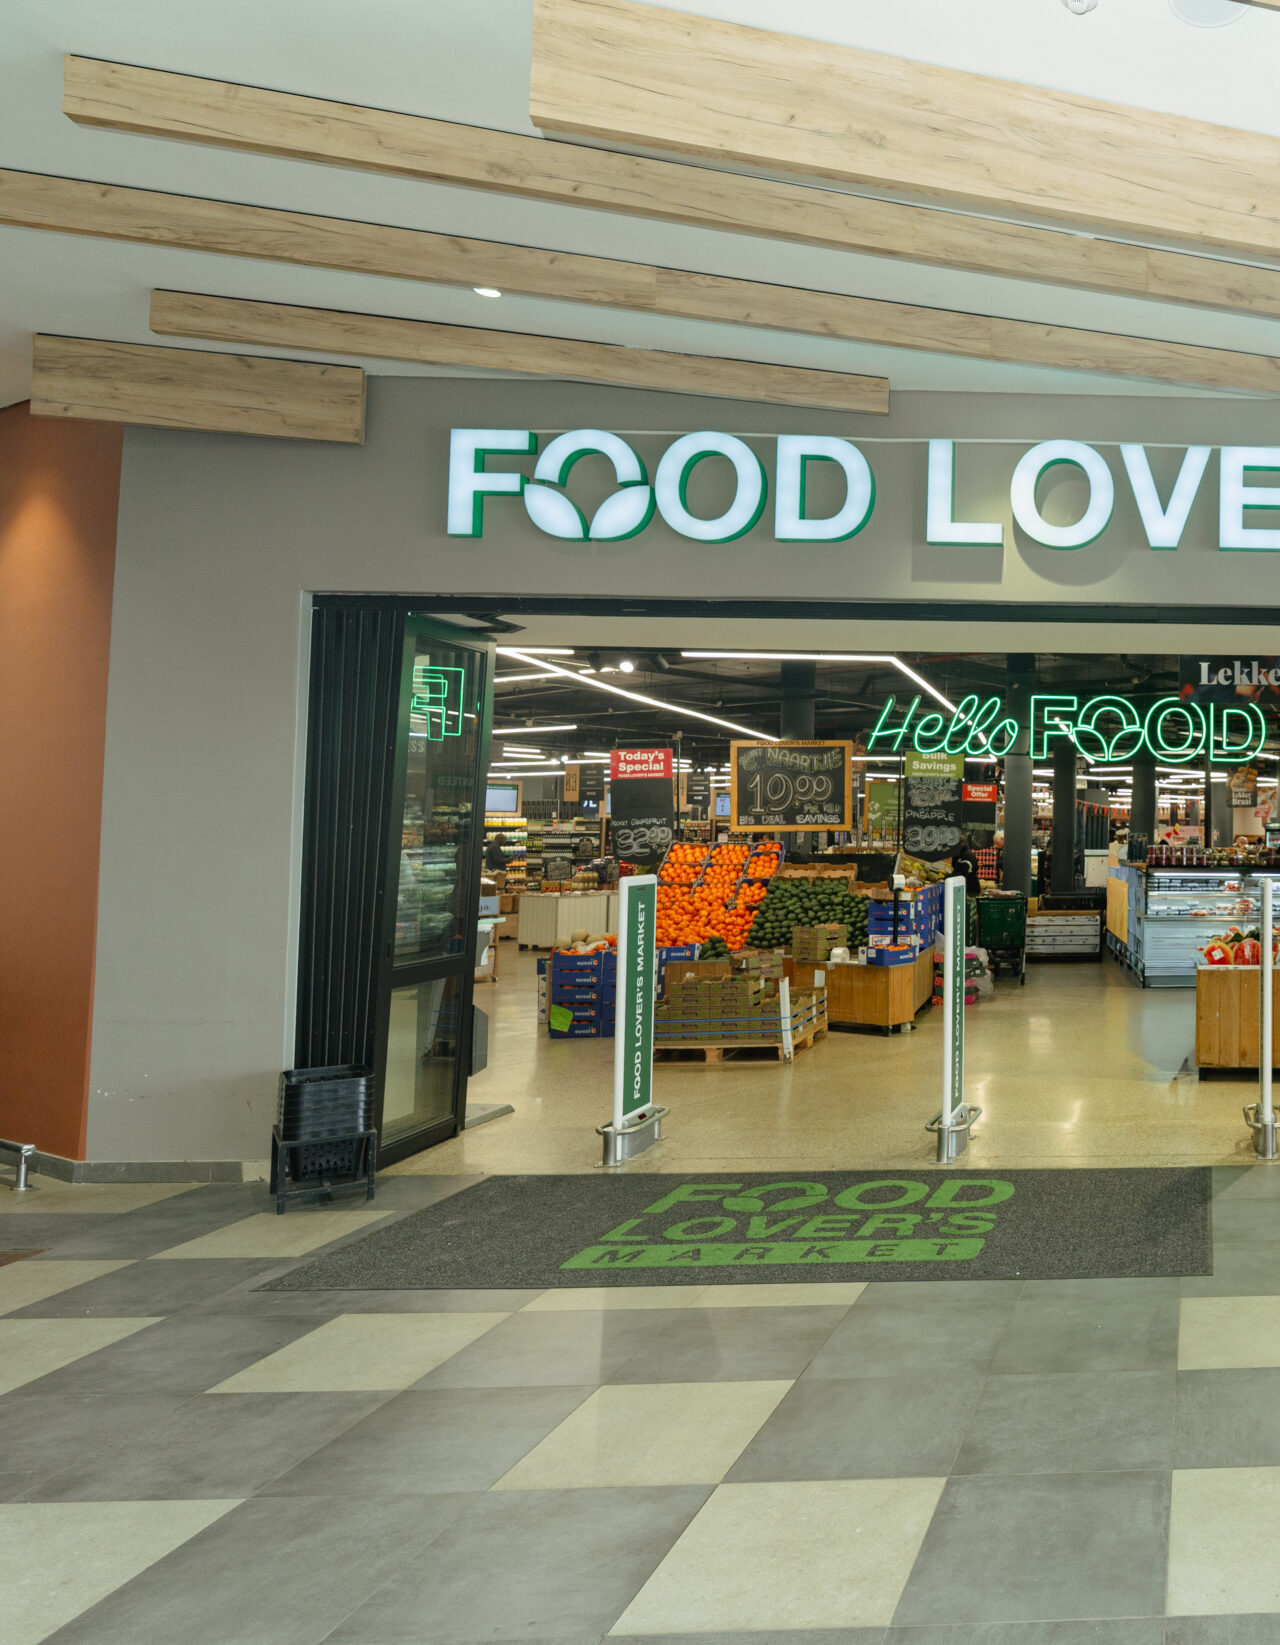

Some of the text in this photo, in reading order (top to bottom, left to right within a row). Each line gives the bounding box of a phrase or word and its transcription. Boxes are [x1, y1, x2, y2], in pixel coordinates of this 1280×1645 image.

[447, 429, 876, 543] FOOD
[867, 694, 1019, 757] Hello
[1029, 695, 1266, 763] FOOD
[618, 751, 665, 761] Today's
[618, 762, 664, 773] Special
[912, 761, 957, 773] Savings
[967, 785, 993, 793] Special
[739, 814, 840, 825] BIG DEAL SAVINGS
[905, 809, 956, 821] PINEAPPLE
[633, 902, 646, 1100] FOOD LOVER'S MARKET
[641, 1179, 1016, 1214] FOOD
[600, 1211, 997, 1242] LOVER'S
[592, 1242, 960, 1265] MARKET
